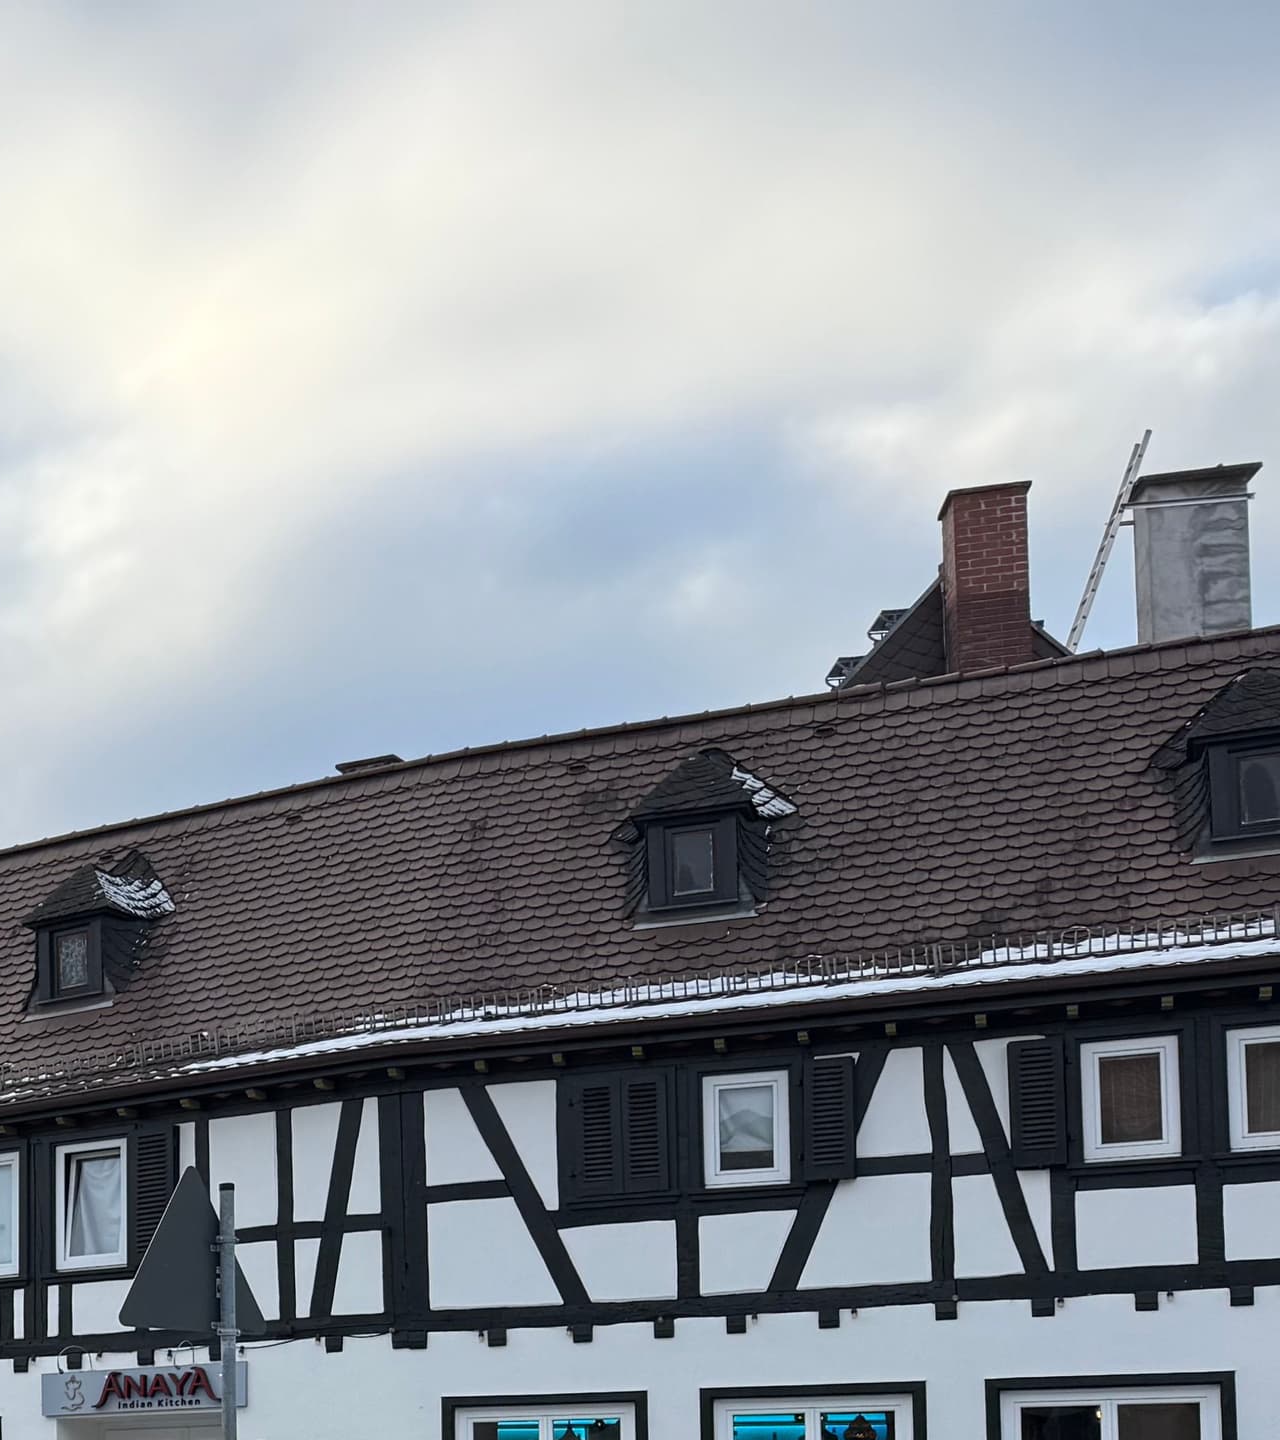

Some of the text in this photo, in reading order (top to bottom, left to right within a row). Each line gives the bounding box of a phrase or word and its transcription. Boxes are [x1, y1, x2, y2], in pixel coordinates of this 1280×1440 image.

[91, 1366, 222, 1409] ANAYA
[118, 1399, 201, 1409] Indian Kitchen
